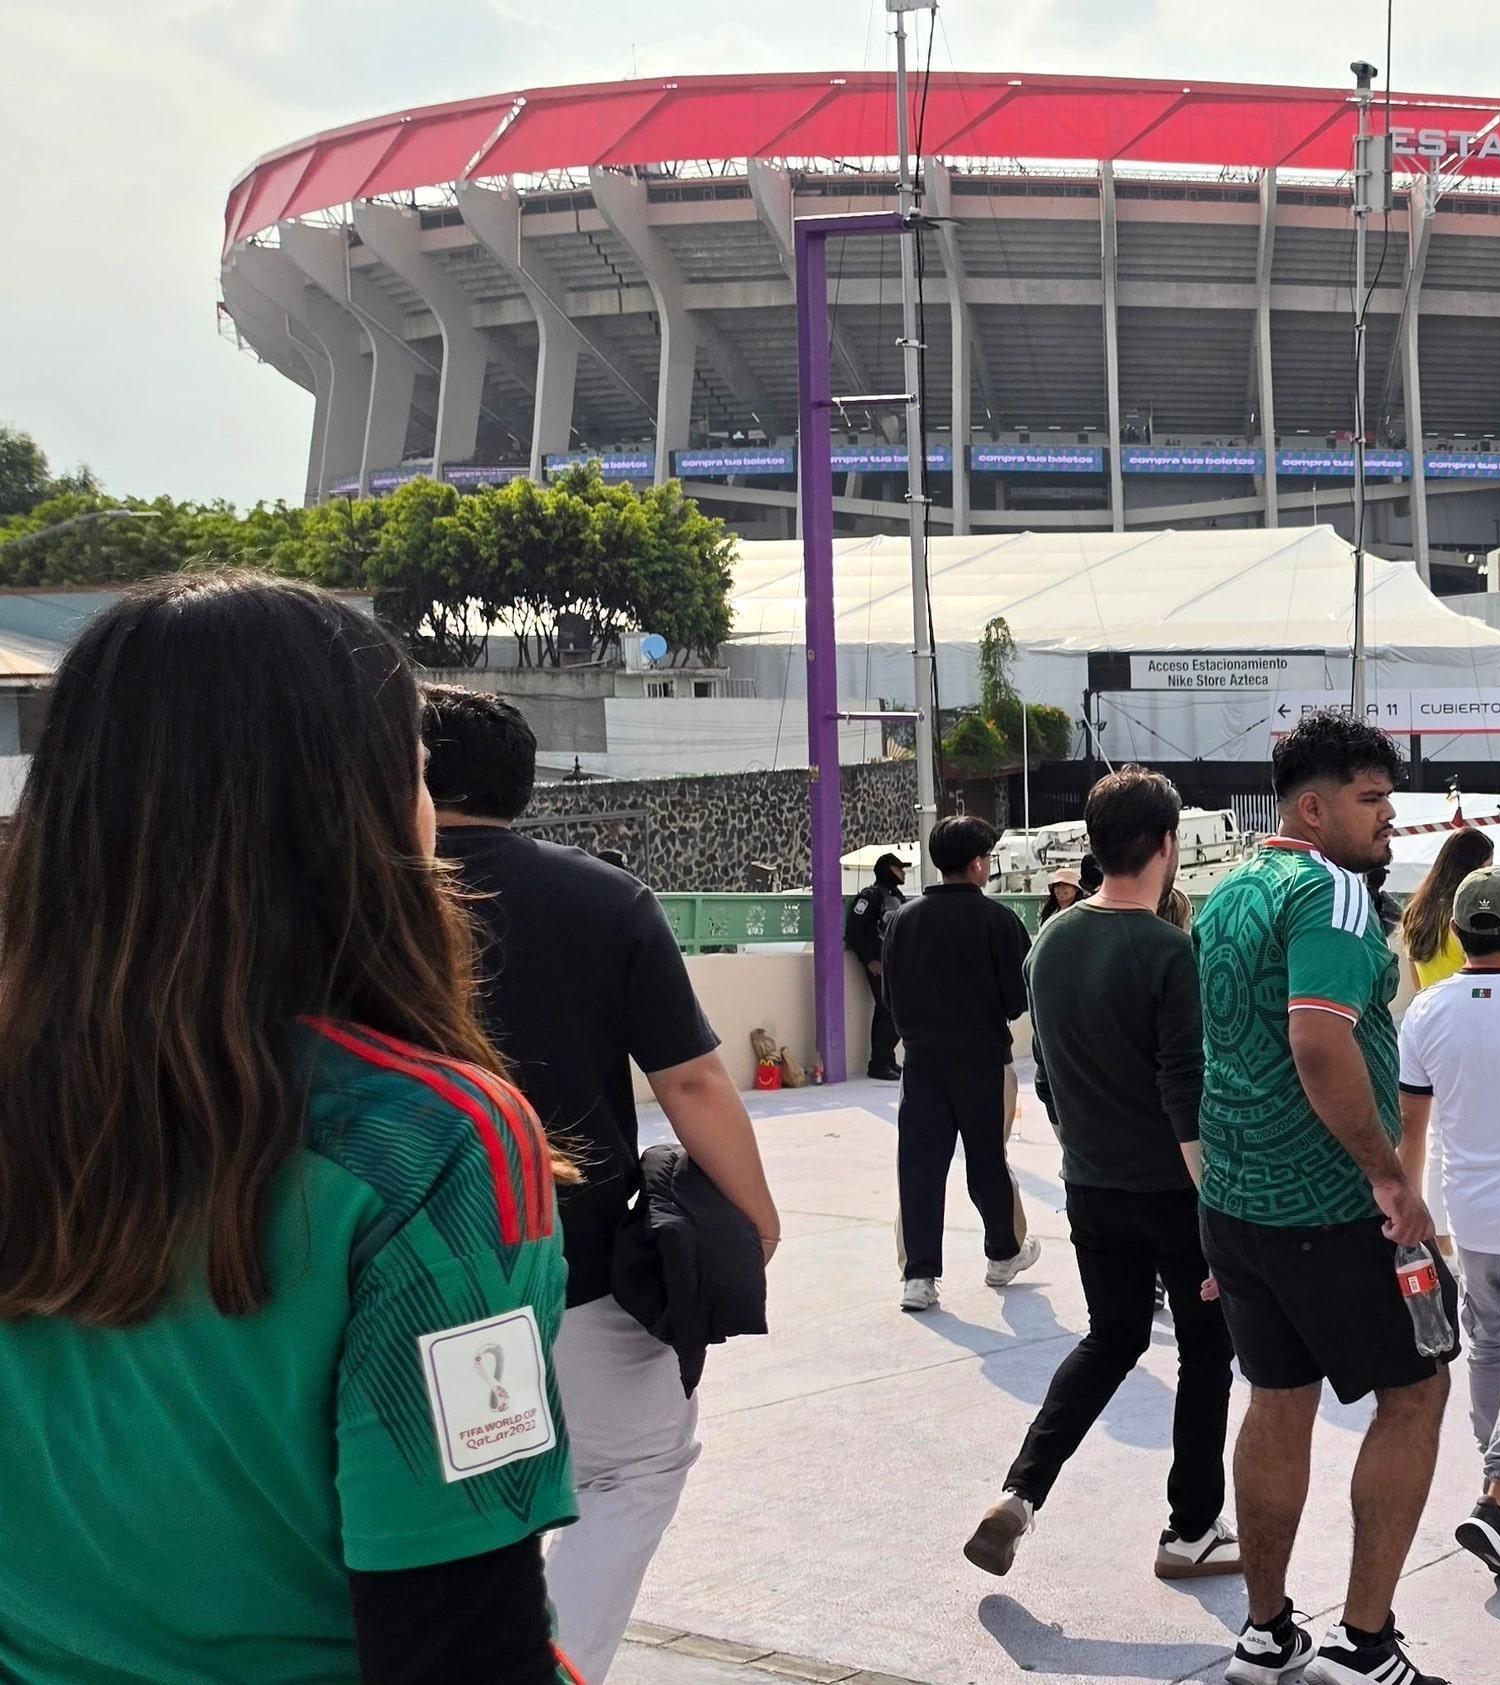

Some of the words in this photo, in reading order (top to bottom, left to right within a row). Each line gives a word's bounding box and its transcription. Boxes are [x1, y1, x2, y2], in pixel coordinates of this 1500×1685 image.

[682, 456, 723, 468] compra
[724, 458, 742, 466] tus
[830, 454, 868, 464] mpra
[893, 455, 944, 463] boos
[978, 455, 1025, 464] compra
[1026, 455, 1047, 463] tus
[1129, 457, 1180, 467] compra
[1182, 457, 1204, 465] tus
[1205, 457, 1255, 466] boletos
[1282, 459, 1332, 469] compra
[1333, 459, 1353, 467] tus
[1362, 460, 1403, 468] oletos
[1428, 461, 1476, 470] compra
[1477, 462, 1497, 470] tus
[1148, 659, 1189, 672] Acceso
[1192, 657, 1288, 671] Estacionamiento
[1168, 674, 1193, 687] Nike
[1196, 674, 1226, 687] Store
[1230, 673, 1269, 686] Azteca
[1387, 703, 1399, 716] 11
[459, 1427, 484, 1441] FIFA
[485, 1414, 523, 1433] WORLD
[523, 1407, 537, 1421] CUP
